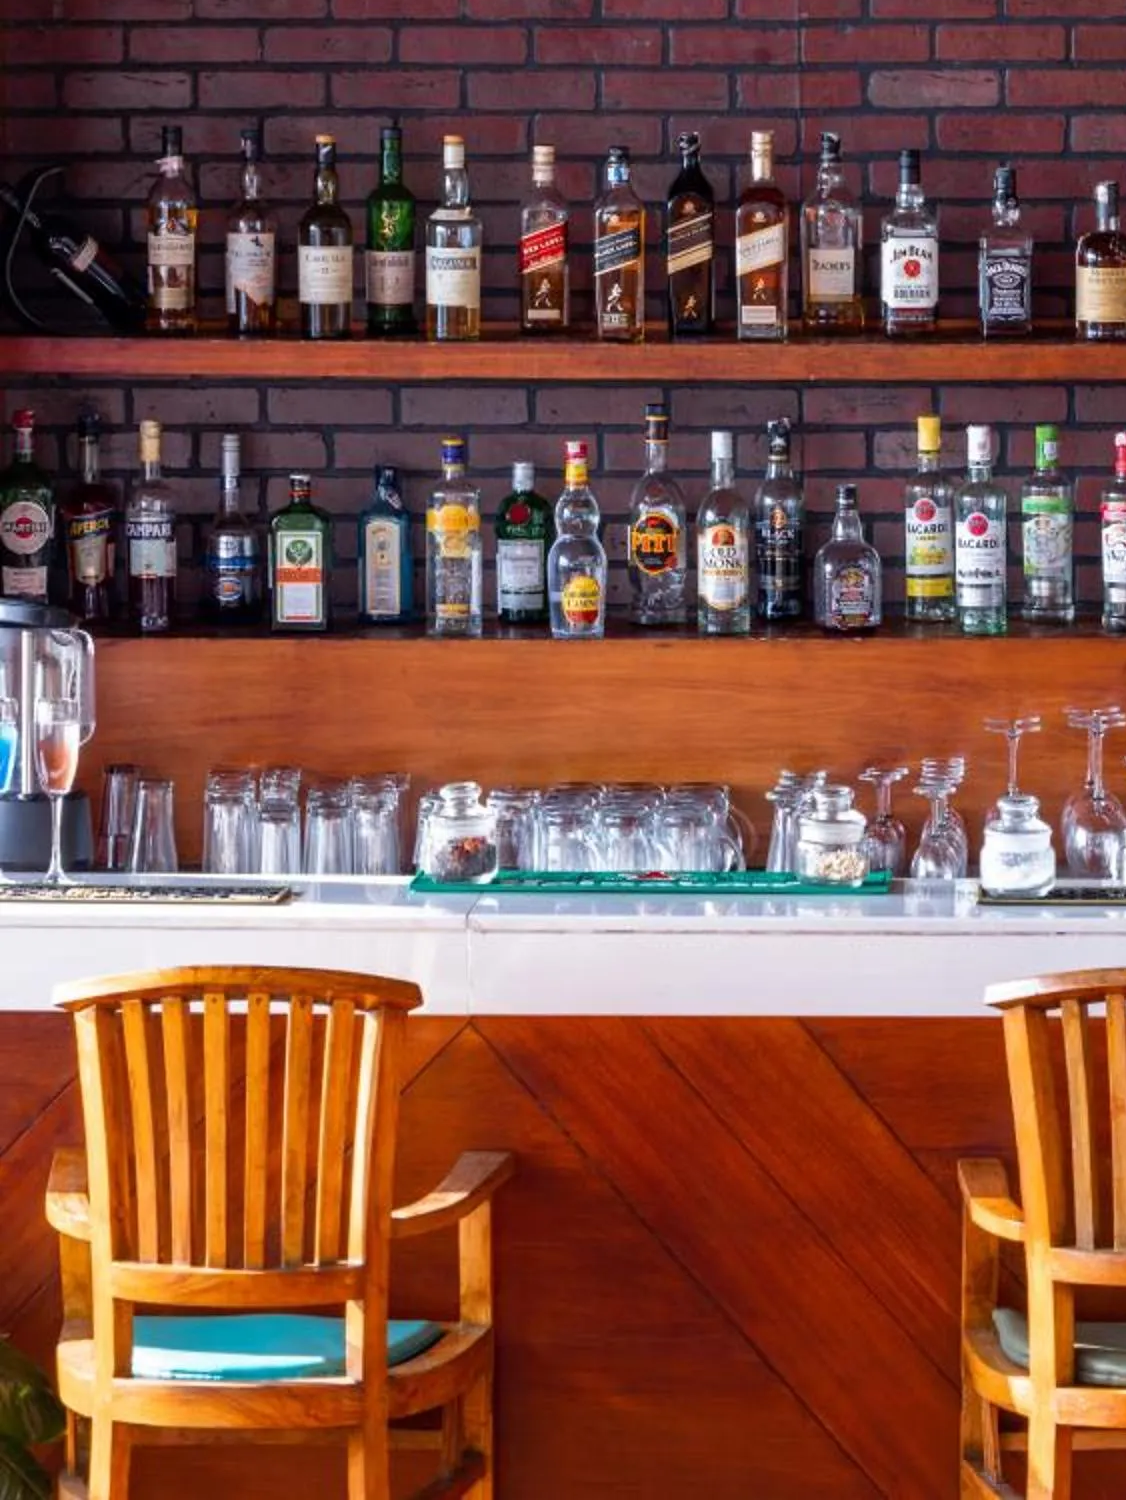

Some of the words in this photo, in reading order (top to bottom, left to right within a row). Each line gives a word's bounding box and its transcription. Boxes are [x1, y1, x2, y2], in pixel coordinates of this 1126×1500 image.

[890, 250, 906, 264] JIM
[908, 246, 933, 260] BEAM
[127, 523, 171, 537] CAMPARI
